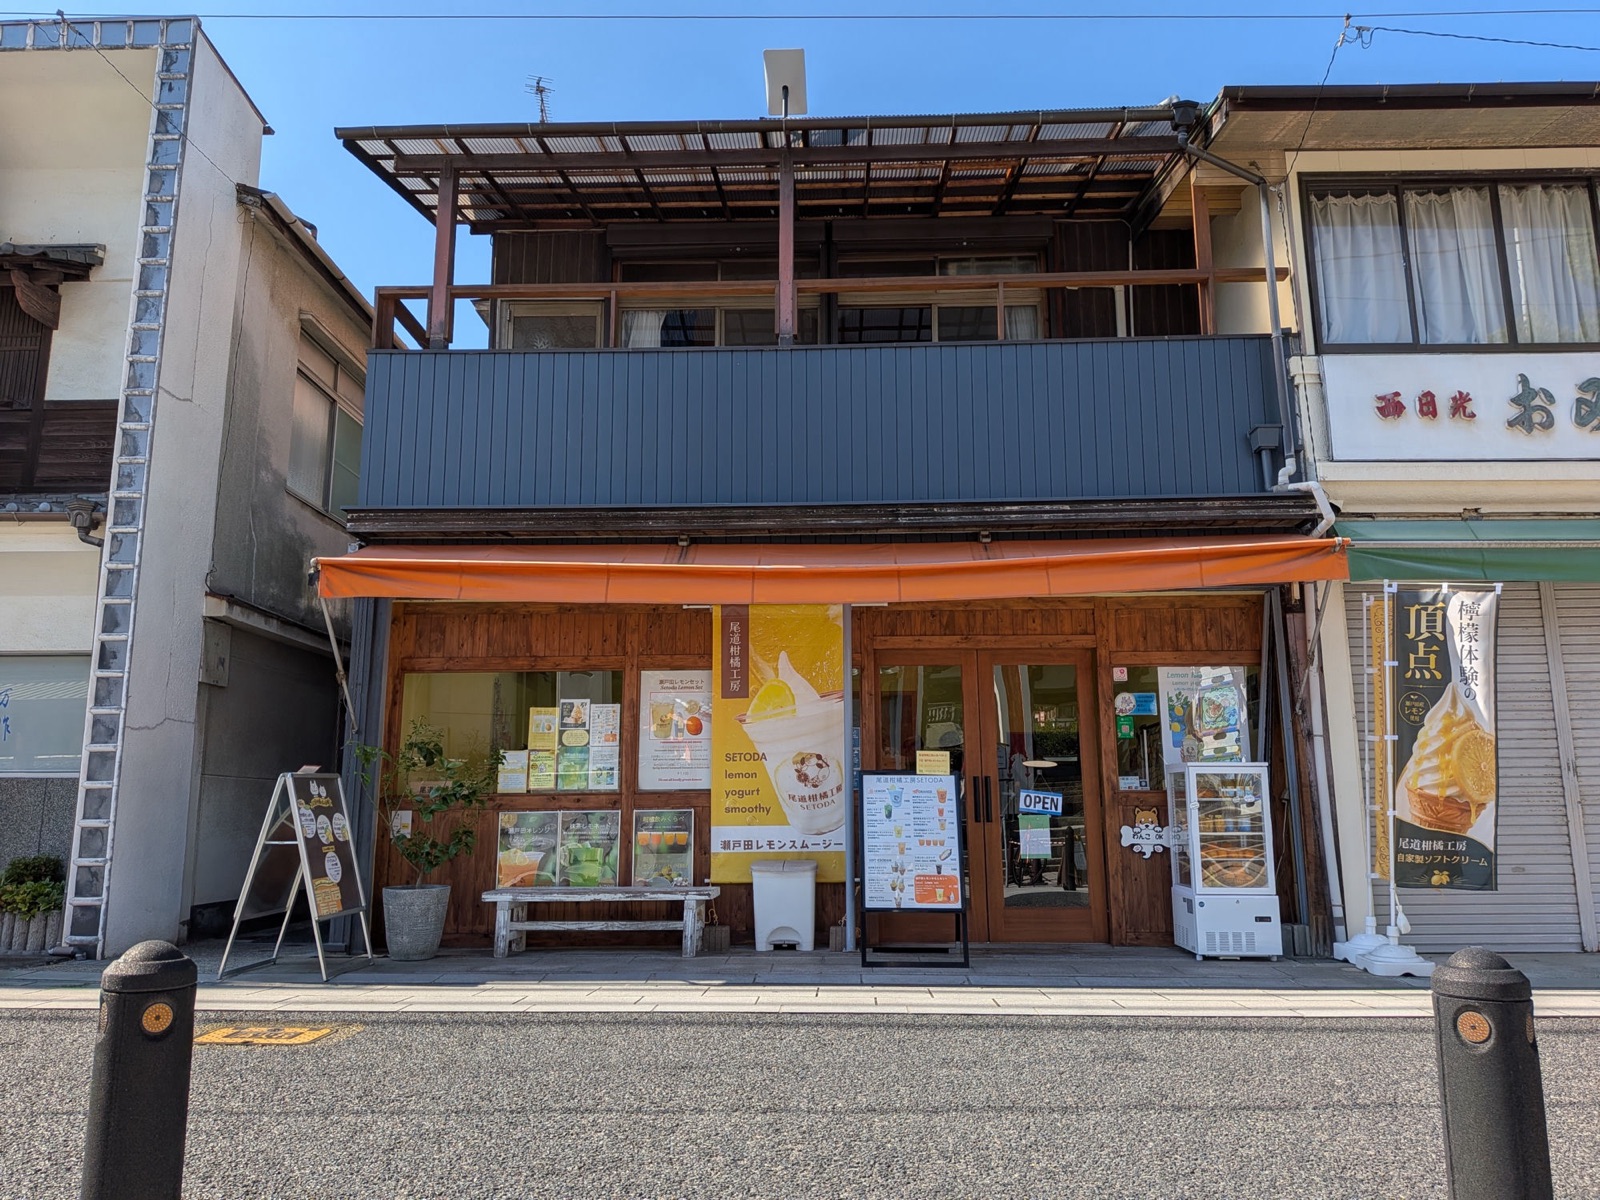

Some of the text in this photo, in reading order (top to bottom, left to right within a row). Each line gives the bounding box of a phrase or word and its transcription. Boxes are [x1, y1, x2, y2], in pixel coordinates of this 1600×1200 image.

[1403, 602, 1445, 680] 頂点
[728, 621, 742, 692] 尾道柑橘工房
[1457, 600, 1481, 701] 檸檬体験の
[1405, 707, 1425, 715] レモン
[725, 752, 768, 762] SETODA
[724, 769, 758, 779] lemon
[724, 787, 760, 799] yogurt
[788, 784, 843, 803] 尾道柑橘工房
[800, 799, 836, 811] SETODA
[1024, 794, 1059, 811] OPEN
[725, 803, 772, 816] smoothy
[720, 839, 843, 851] 瀬戸田レモンスムージー
[1398, 837, 1467, 852] 尾道柑橘工房
[1397, 853, 1488, 866] 自家製ソフトクリーム
